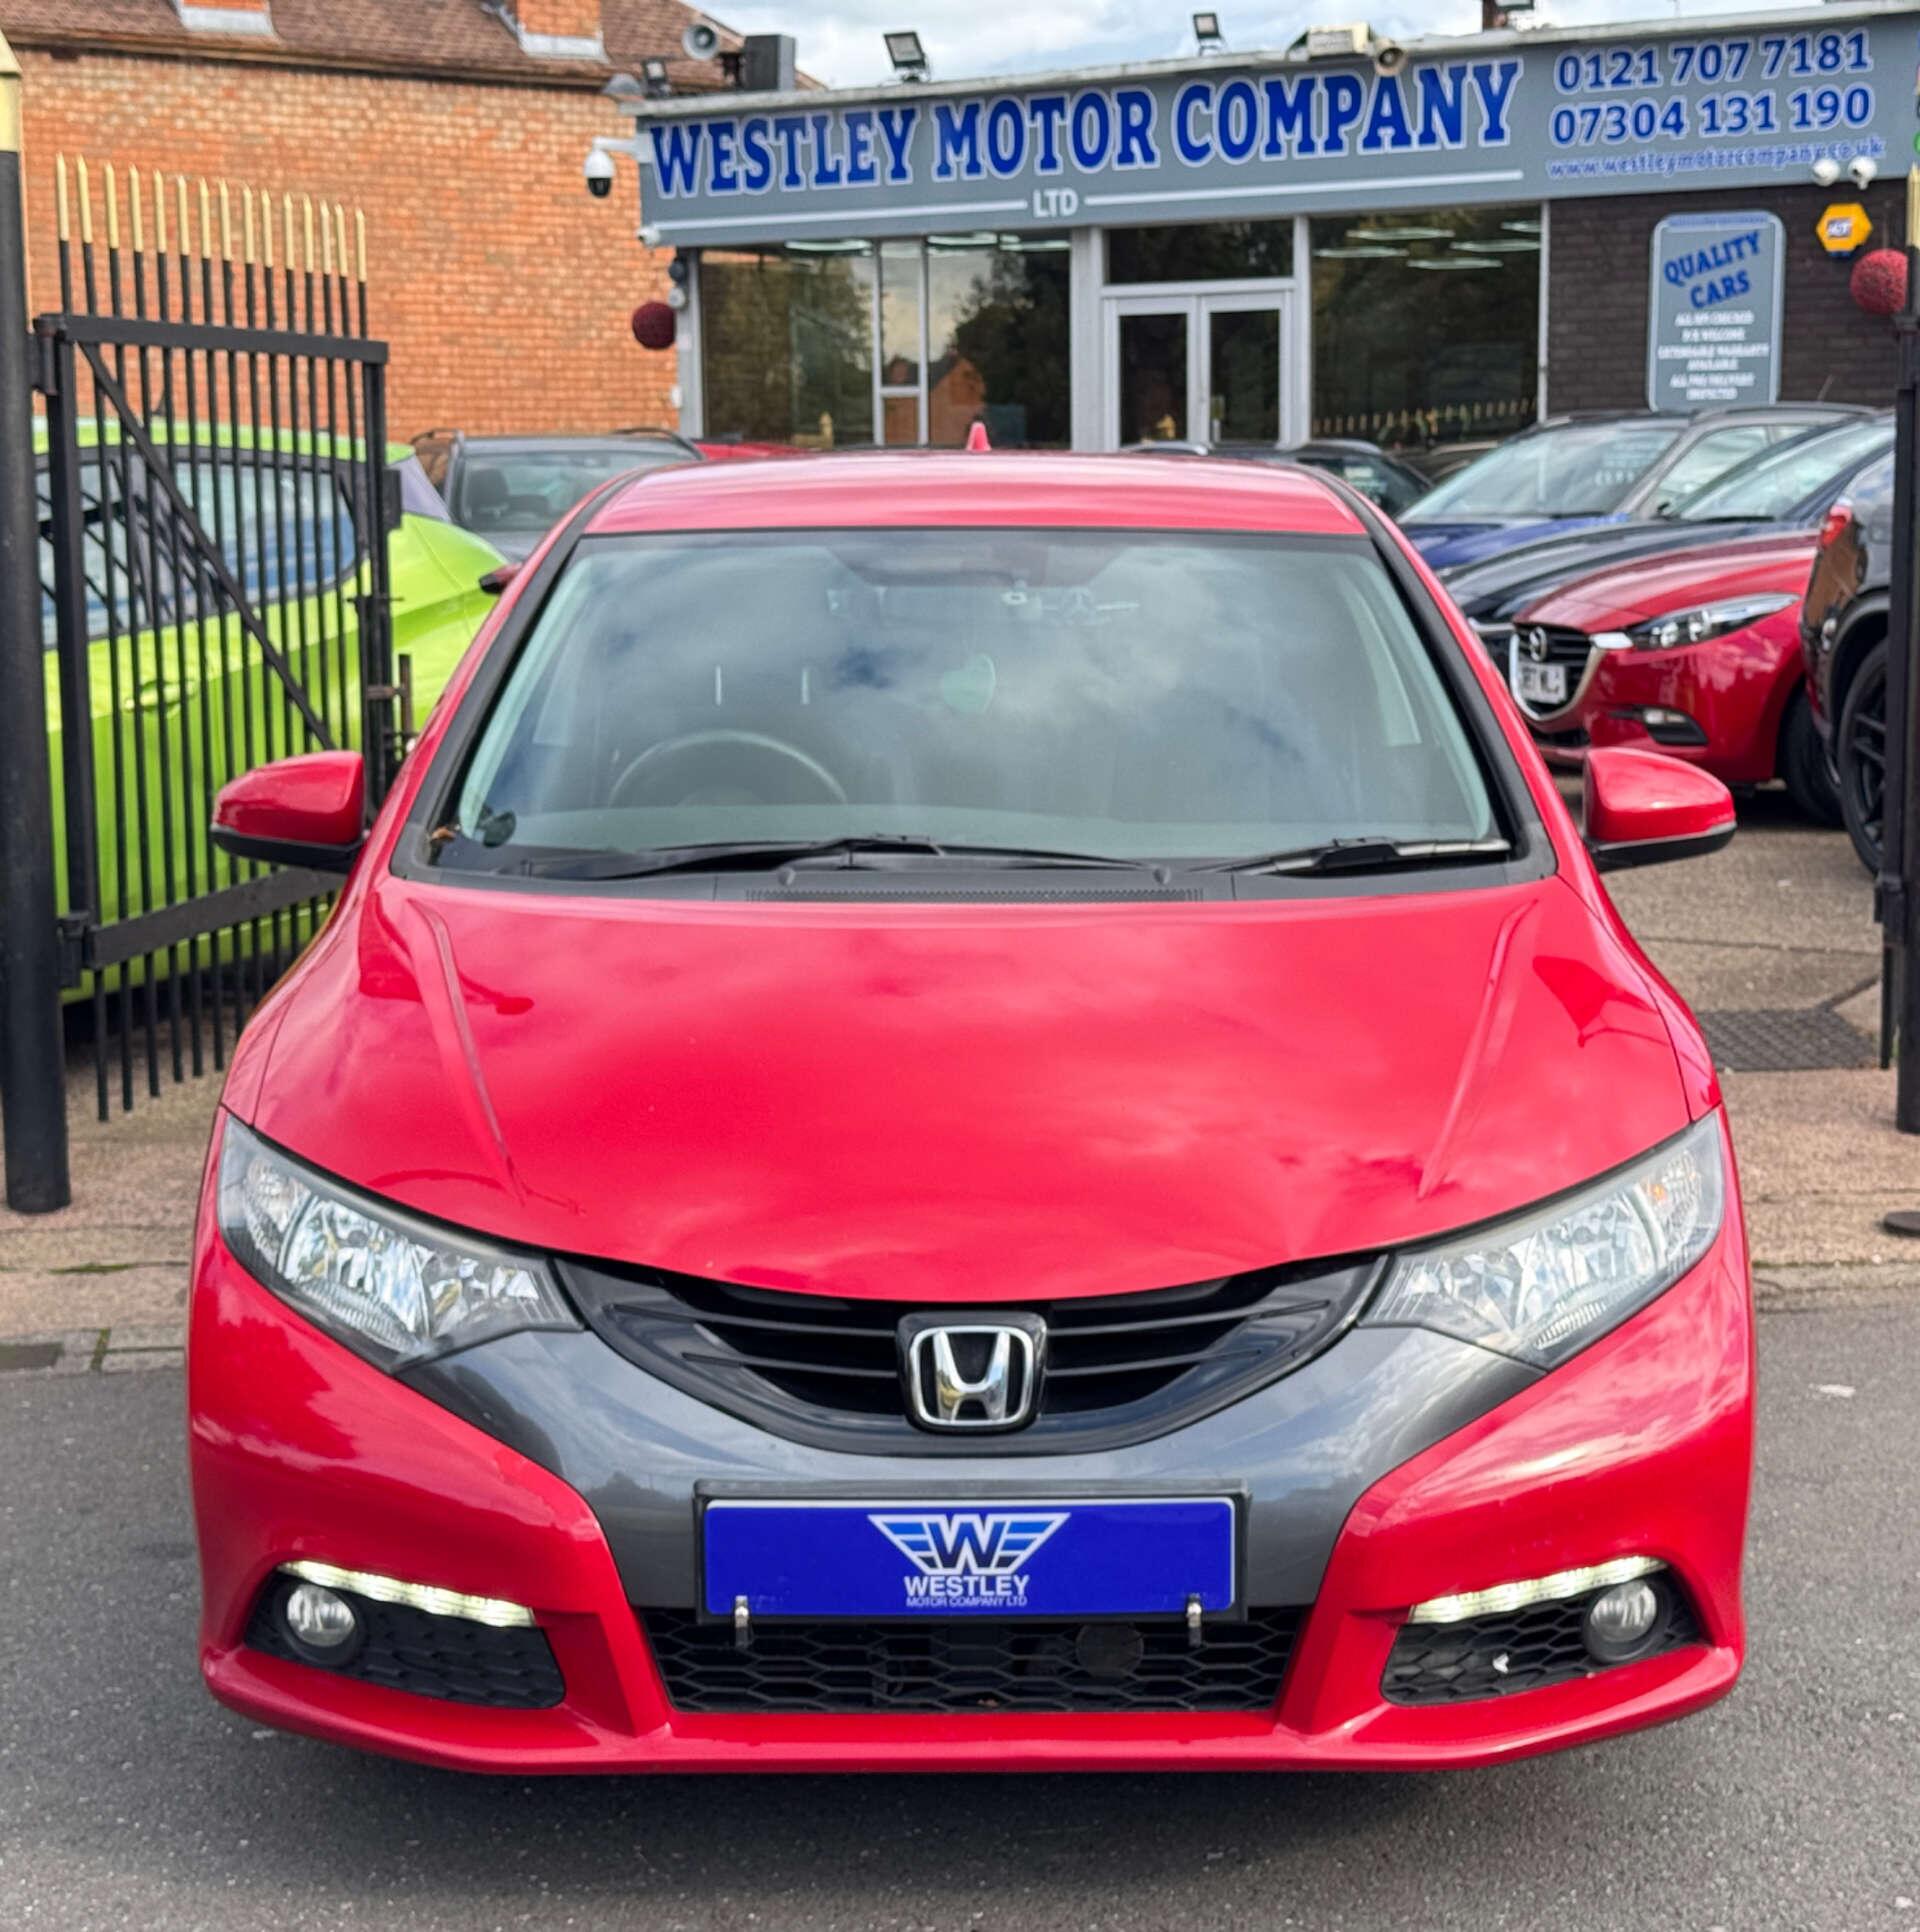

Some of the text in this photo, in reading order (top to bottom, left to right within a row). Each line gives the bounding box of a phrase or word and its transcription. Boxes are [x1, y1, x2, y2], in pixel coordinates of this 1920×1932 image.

[1557, 31, 1870, 92] 0121 707 7181
[650, 60, 1521, 196] WESTLEY MOTOR COMPANY
[1552, 86, 1872, 144] 07304 131 190
[1033, 188, 1078, 218] LTD
[1663, 231, 1761, 287] QUALITY
[1690, 269, 1751, 309] CARS
[904, 1574, 1030, 1597] WESTLEY
[906, 1595, 1028, 1607] MOTOR COMPANY LTD
